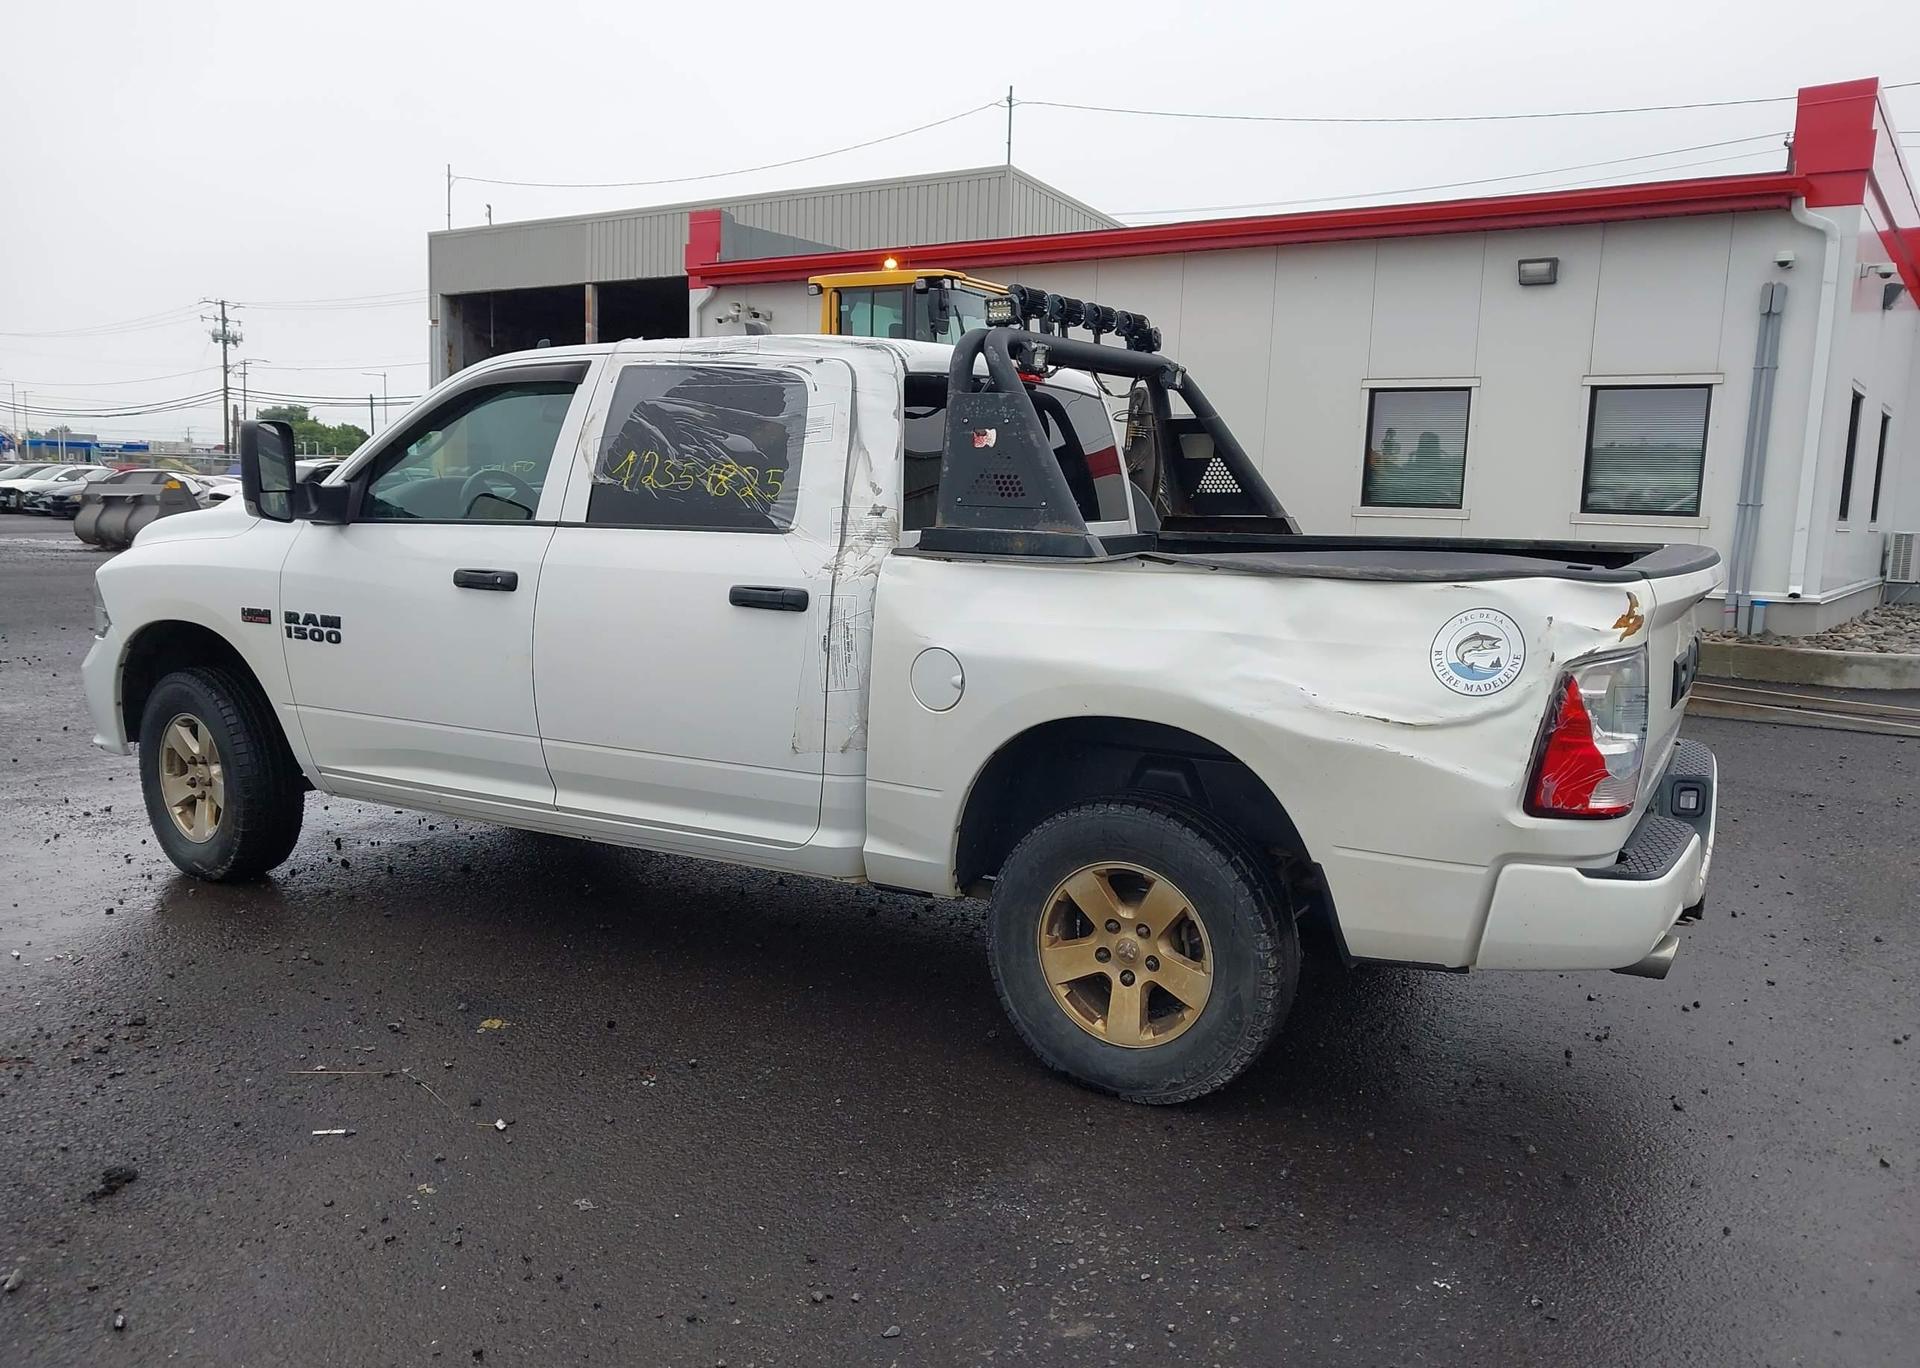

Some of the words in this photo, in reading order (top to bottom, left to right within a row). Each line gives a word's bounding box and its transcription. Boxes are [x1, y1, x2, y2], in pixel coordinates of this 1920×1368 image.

[284, 610, 342, 630] RAM
[1494, 615, 1504, 625] LA
[285, 625, 342, 645] 1500
[1463, 653, 1522, 692] MADELEINE
